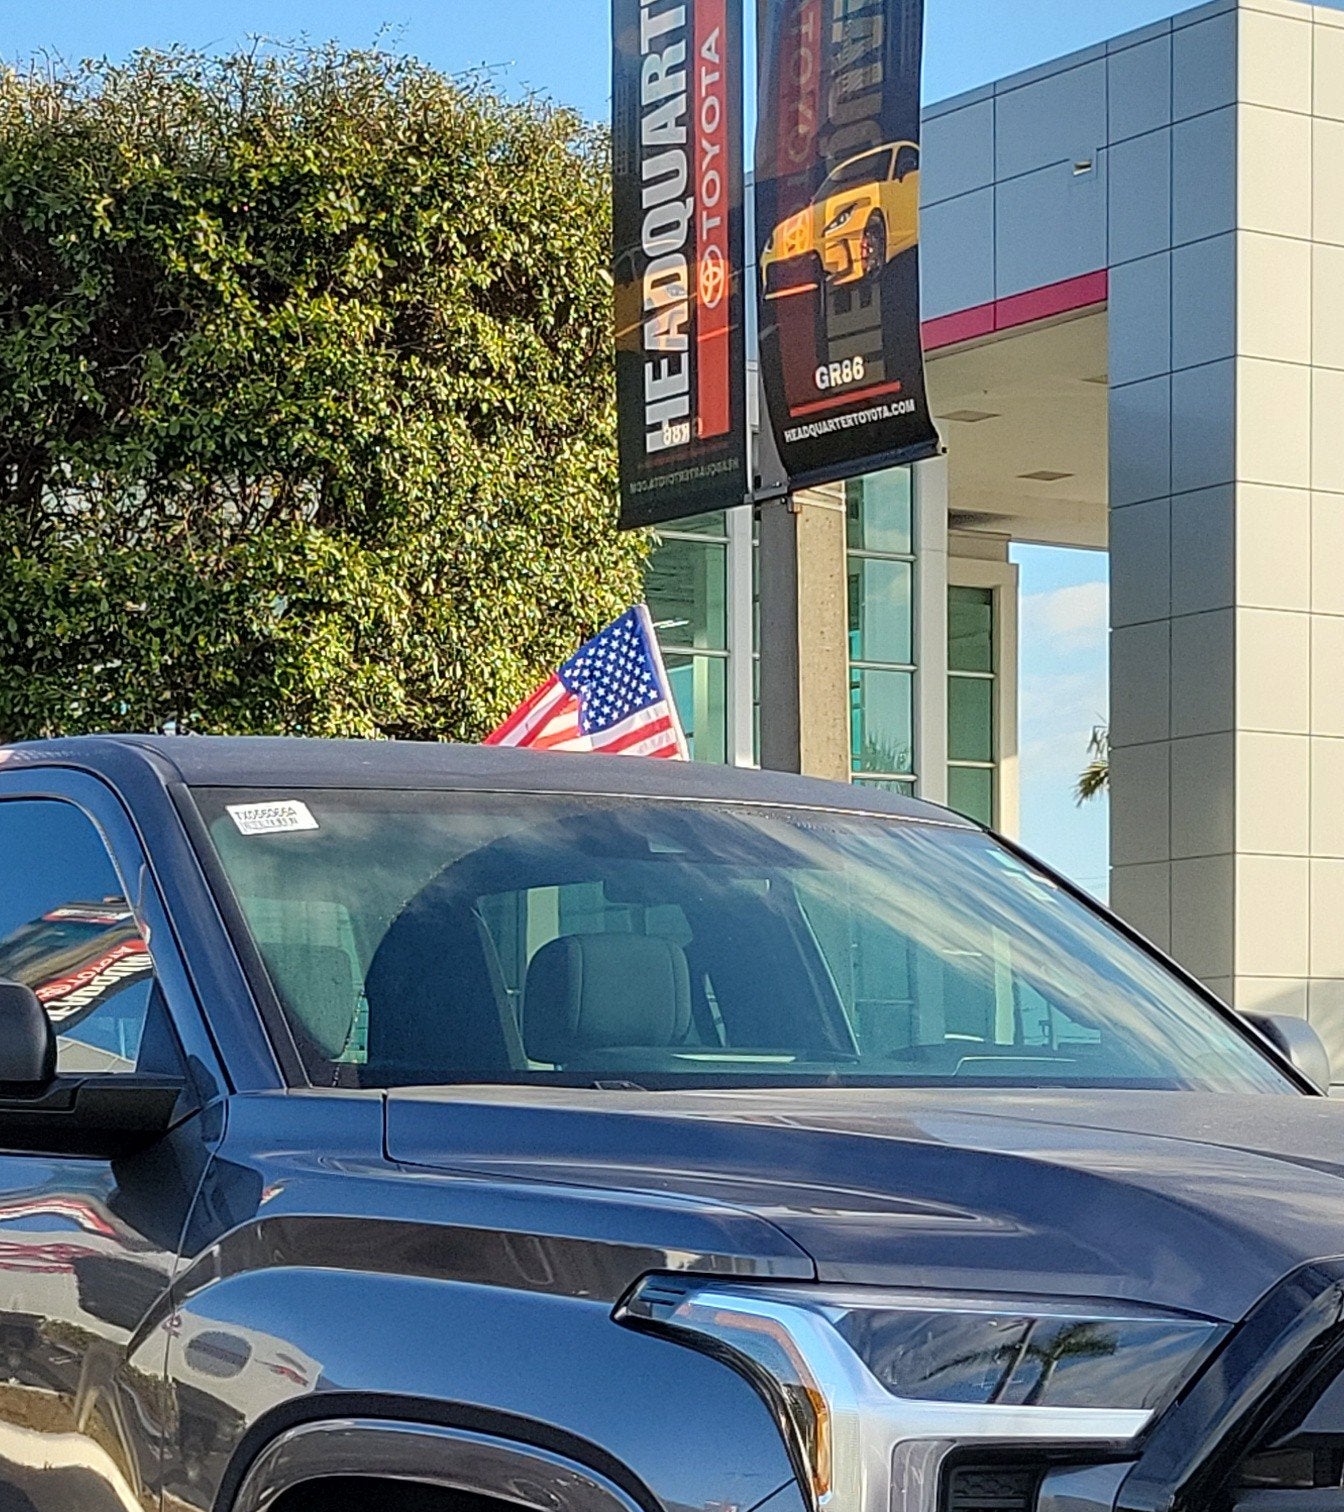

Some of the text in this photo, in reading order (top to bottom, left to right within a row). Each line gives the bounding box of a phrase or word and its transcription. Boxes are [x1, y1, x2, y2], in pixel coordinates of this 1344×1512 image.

[700, 26, 722, 242] TOYOTA
[639, 0, 694, 453] HEADQUART
[783, 398, 916, 443] HEADQUARTERTOYOTA.COM
[814, 355, 865, 391] GR86
